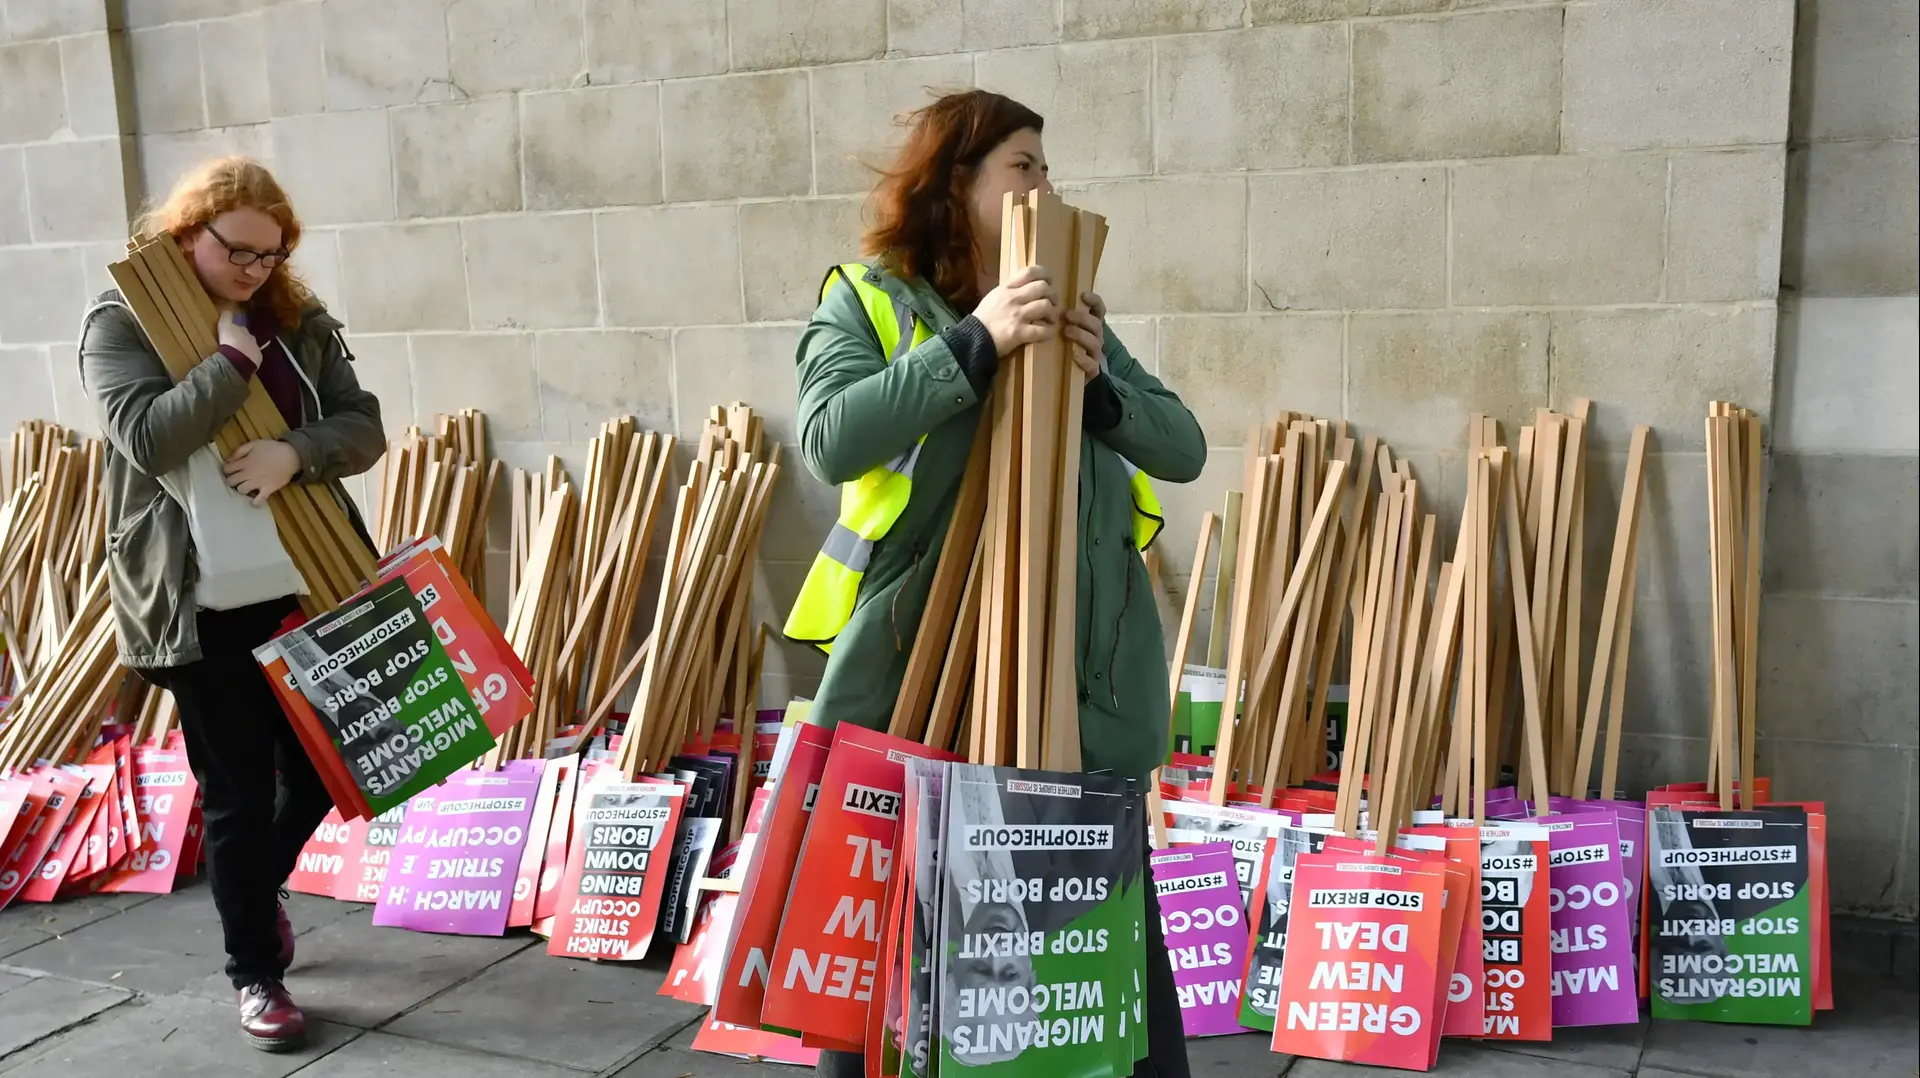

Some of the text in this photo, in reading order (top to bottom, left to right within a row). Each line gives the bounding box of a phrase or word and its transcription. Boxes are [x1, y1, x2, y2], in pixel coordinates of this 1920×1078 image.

[311, 612, 411, 681] #STOPTHECOUP
[386, 639, 430, 677] STOP
[325, 671, 383, 713] BORIS
[404, 666, 449, 705] STOP
[339, 696, 402, 746] BREXIT
[356, 697, 466, 775] WELCOME
[366, 712, 478, 797] MIGRANTS
[1009, 781, 1080, 797] ANOTHER EUROPE IS POSSIBLE
[440, 799, 523, 813] #STOPTHECOUP
[424, 826, 522, 848] OCCUPY
[592, 827, 651, 845] BORIS
[969, 829, 1109, 847] #STOPTHECOUP
[1486, 830, 1510, 838] ANOTHER
[584, 851, 648, 870] DOWN
[1664, 849, 1792, 863] #STOPTHECOUP
[426, 858, 505, 879] STRIKE
[665, 828, 694, 929] #STOPTHECOUP
[1380, 865, 1400, 873] ANOTHER
[581, 876, 643, 895] BRING
[966, 877, 1108, 904] STOP BORIS
[1663, 881, 1795, 900] STOP BORIS
[413, 890, 502, 911] MARCH
[571, 898, 640, 915] OCCUPY
[1312, 892, 1420, 907] STOP BREXIT
[574, 918, 630, 936] STRIKE
[1315, 921, 1409, 953] DEAL
[1660, 917, 1800, 936] STOP BREXIT
[566, 936, 630, 954] MARCH
[958, 928, 1109, 959] STOP BREXIT
[1662, 953, 1800, 974] WELCOME
[1308, 961, 1404, 993] NEW
[1659, 977, 1800, 998] MIGRANTS
[958, 980, 1104, 1018] WELCOME
[1287, 1001, 1421, 1036] GREEN
[952, 1014, 1104, 1055] MIGRANTS
